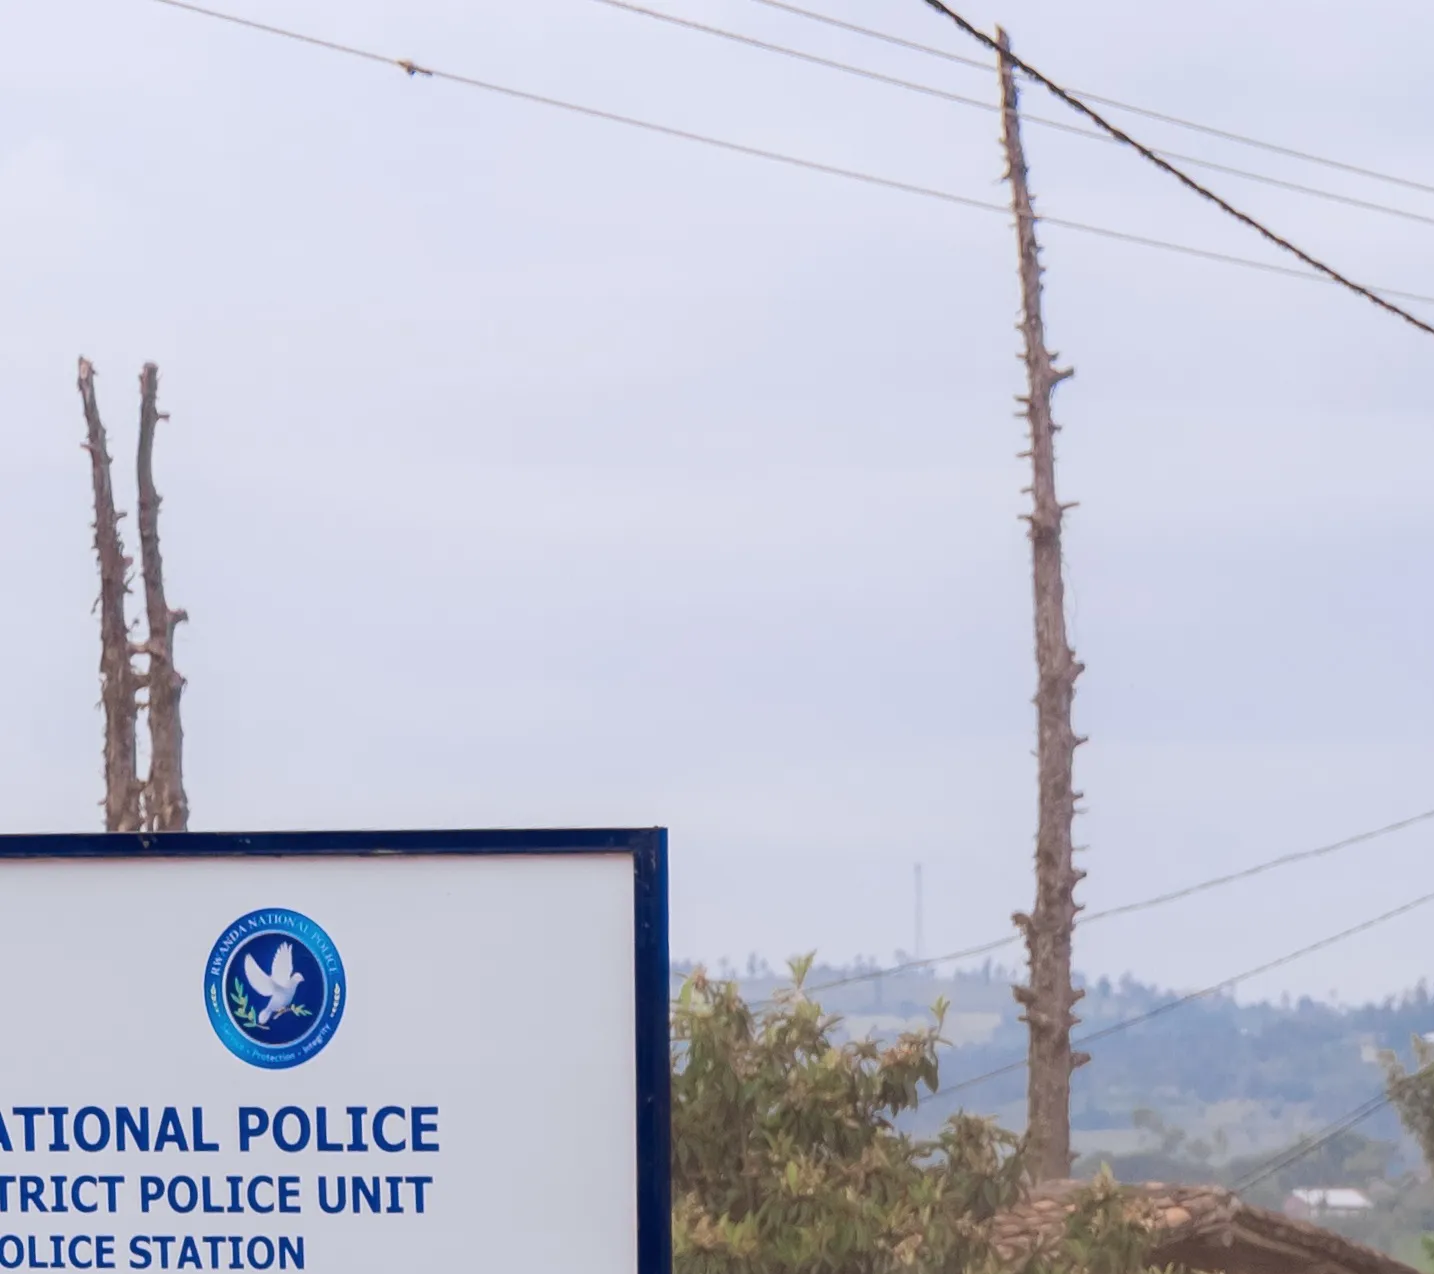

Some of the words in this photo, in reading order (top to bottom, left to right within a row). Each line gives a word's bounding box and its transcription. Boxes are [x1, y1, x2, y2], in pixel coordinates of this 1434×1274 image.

[210, 924, 248, 976] RWANDA
[248, 913, 309, 935] NATIONAL
[252, 1050, 296, 1063] Protection
[302, 1023, 332, 1055] Integrity
[238, 1105, 440, 1153] POLICE
[0, 1175, 125, 1213] TRICT
[140, 1175, 301, 1214] POLICE
[318, 1176, 433, 1214] UNIT
[0, 1234, 116, 1269] OLICE
[129, 1235, 305, 1270] STATION
